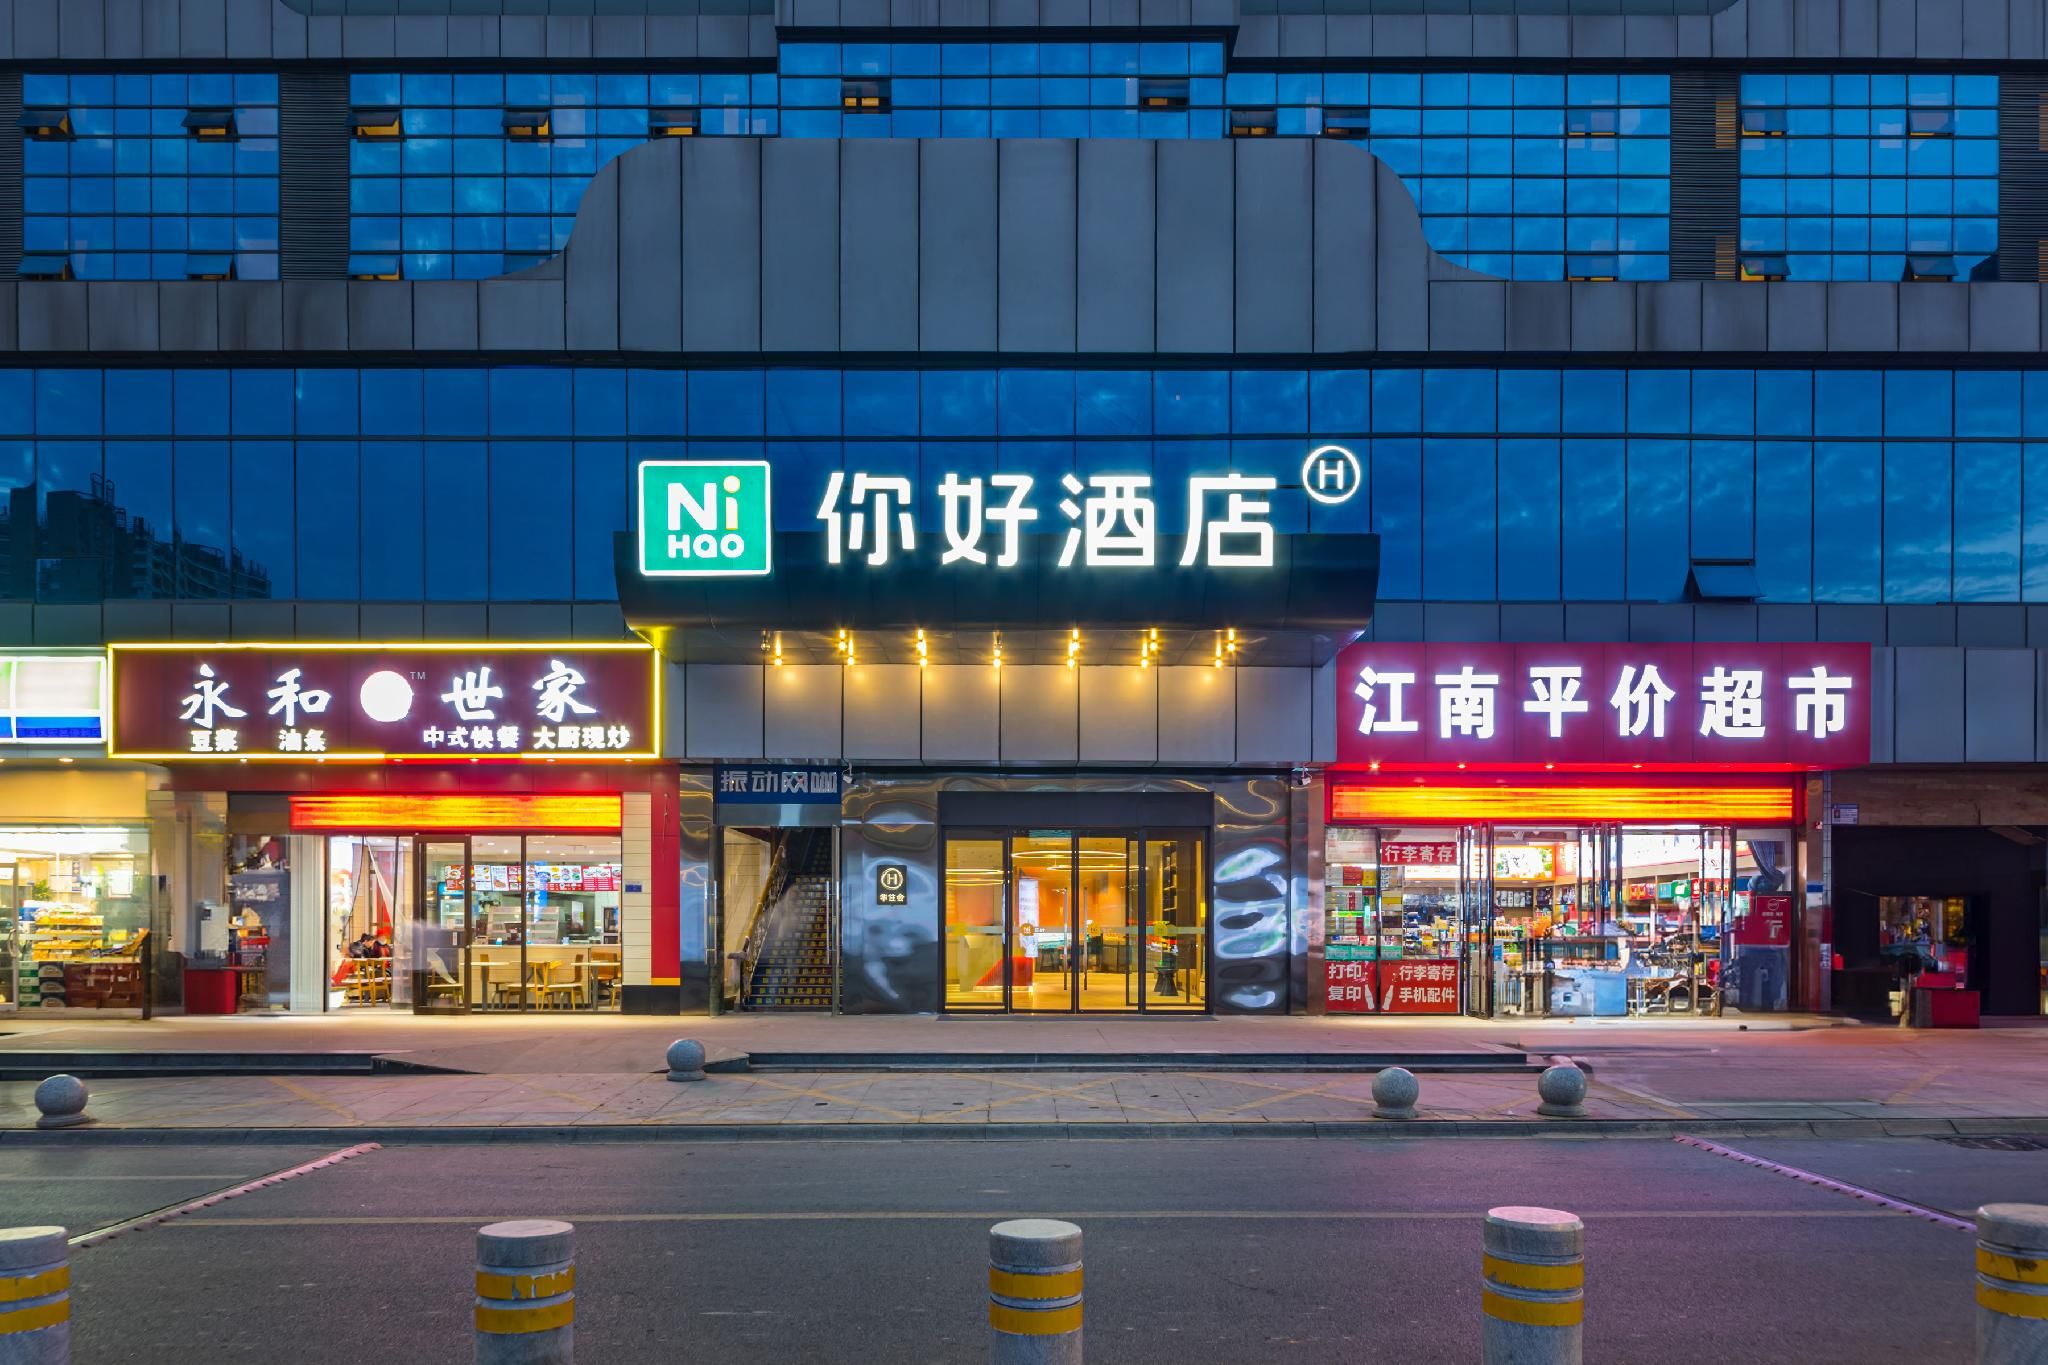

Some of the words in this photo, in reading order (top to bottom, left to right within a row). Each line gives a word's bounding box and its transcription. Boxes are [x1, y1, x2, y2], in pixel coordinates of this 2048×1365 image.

[667, 475, 741, 531] Ni
[816, 470, 1278, 568] 你好酒店
[1355, 664, 1853, 739] 江南平价超市
[423, 725, 520, 749] 中式快餐
[533, 725, 631, 749] 大厨现炒
[720, 770, 838, 793] 振动网咖
[1384, 844, 1454, 863] 行李寄存
[1328, 963, 1362, 980] 打印
[1399, 964, 1456, 981] 行李寄存
[1328, 985, 1362, 1002] 复印
[1399, 986, 1456, 1003] 手机配件
